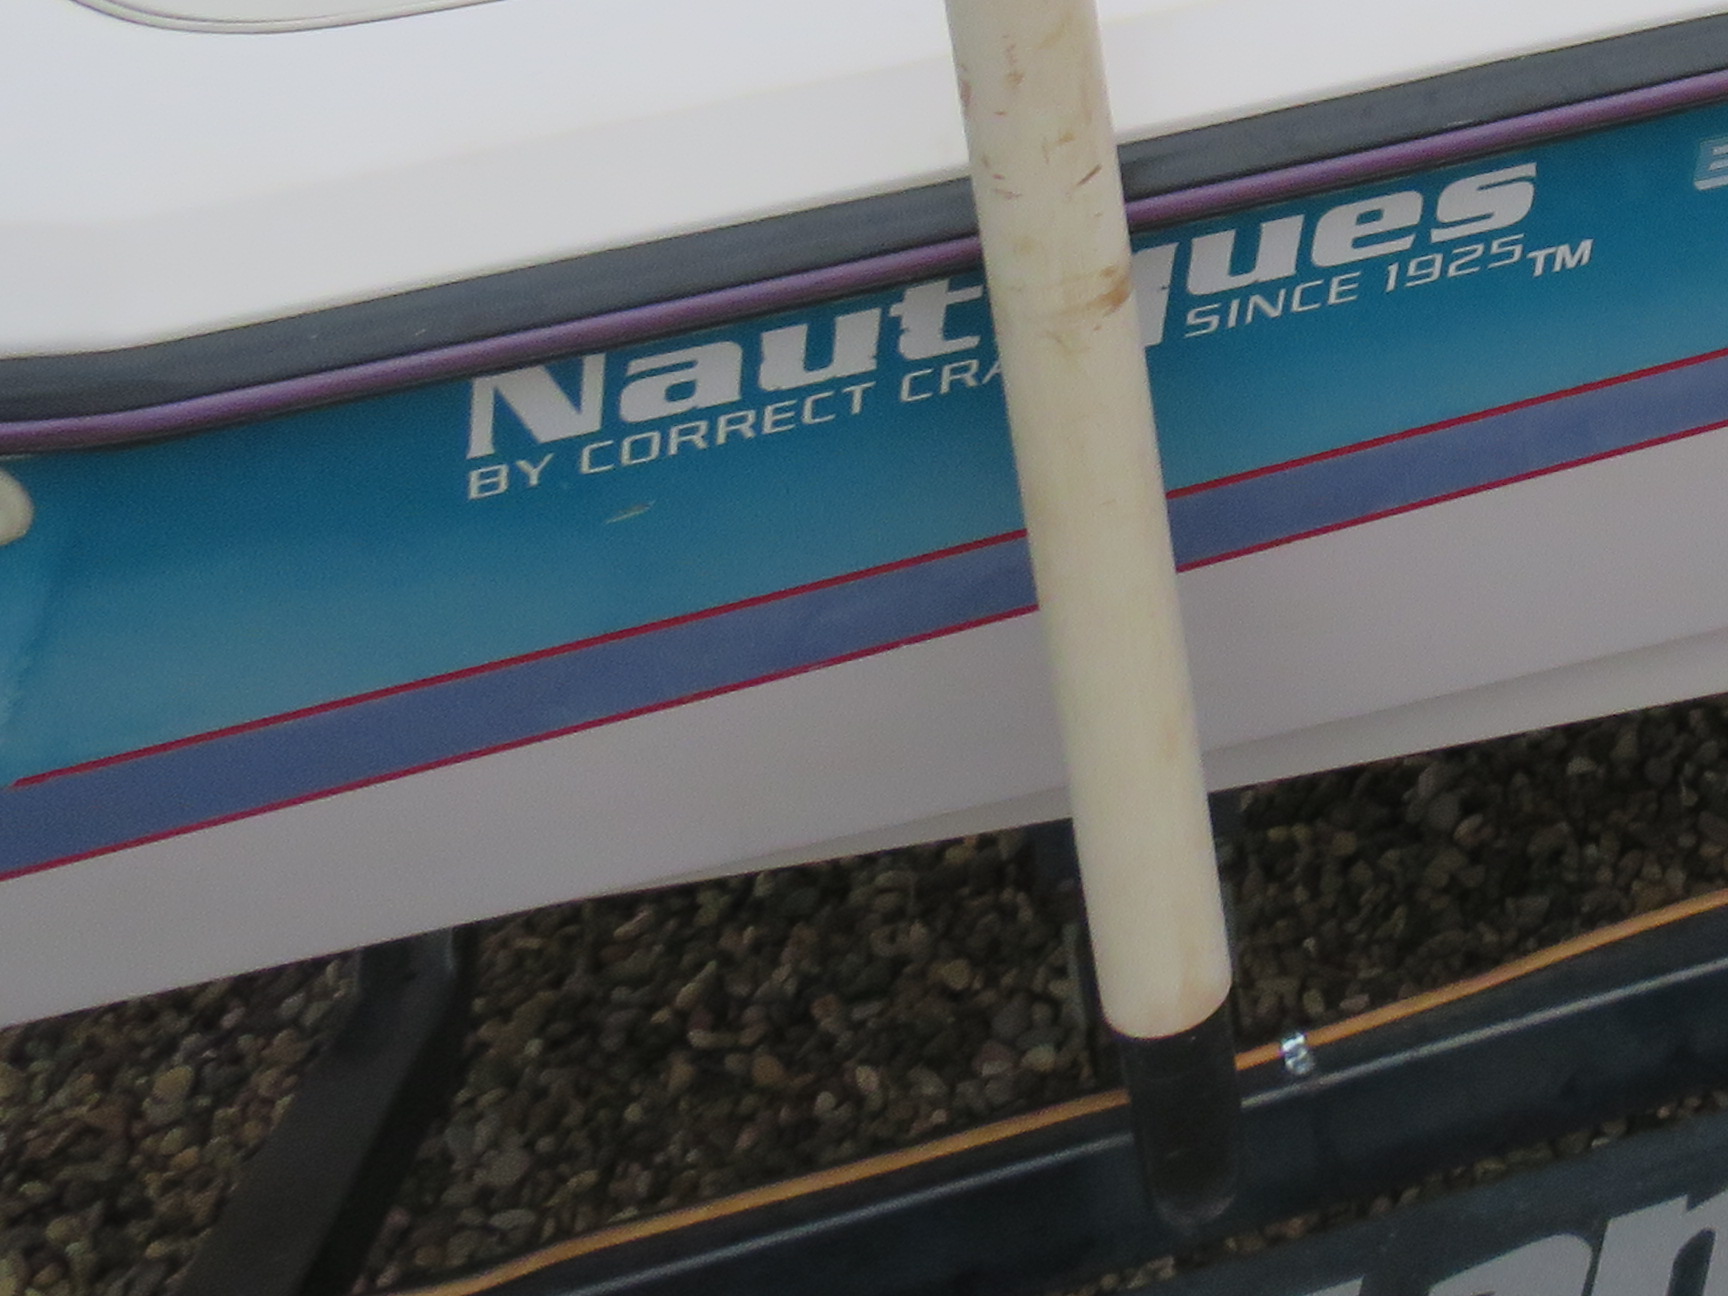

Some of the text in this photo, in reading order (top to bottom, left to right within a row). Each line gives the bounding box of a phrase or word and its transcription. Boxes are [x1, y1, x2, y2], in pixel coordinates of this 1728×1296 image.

[466, 162, 1537, 460] Nautues
[467, 453, 555, 500] BY
[580, 381, 877, 475] CORRECT
[1184, 271, 1361, 340] SINCE
[1384, 232, 1525, 294] 1925
